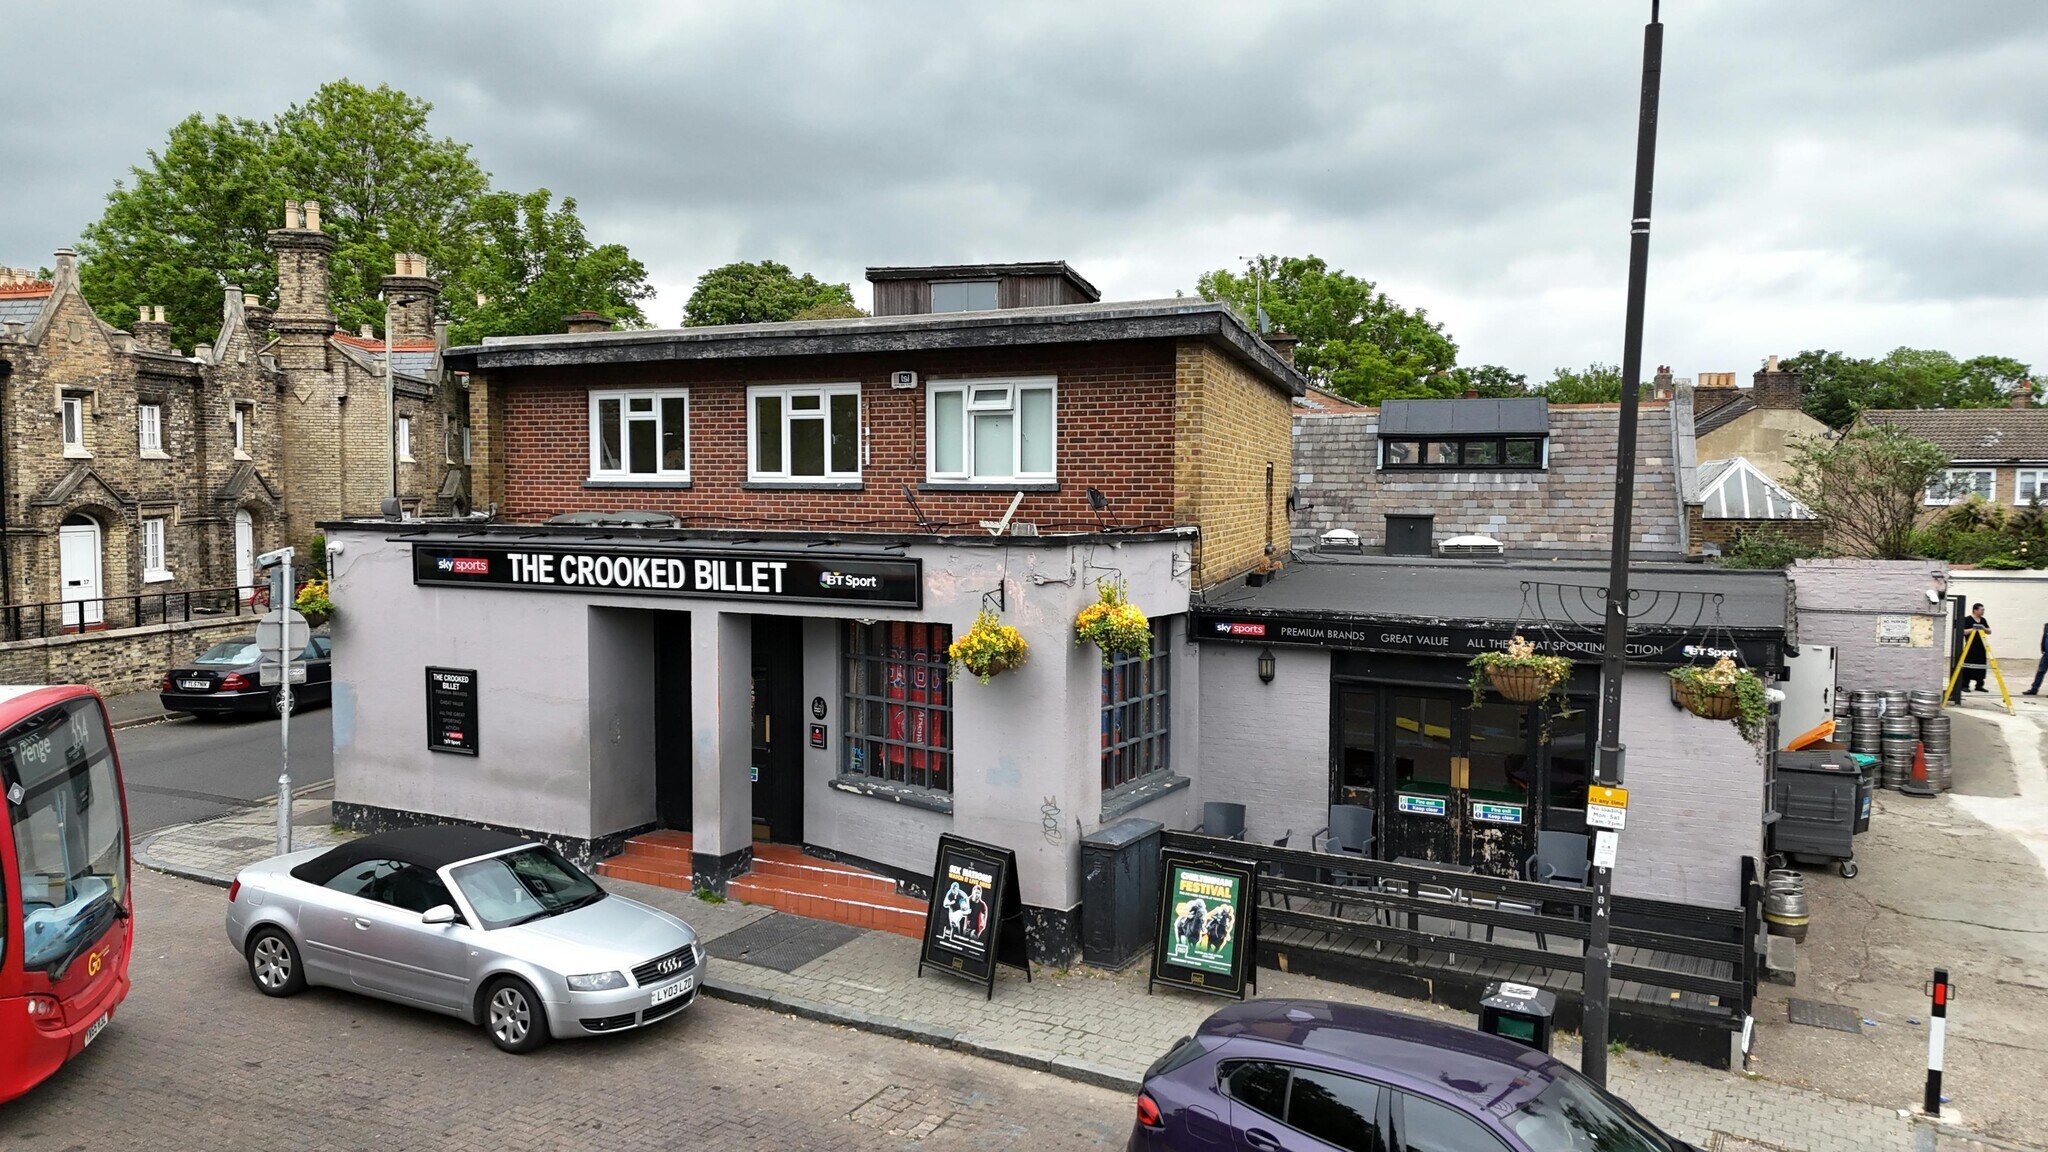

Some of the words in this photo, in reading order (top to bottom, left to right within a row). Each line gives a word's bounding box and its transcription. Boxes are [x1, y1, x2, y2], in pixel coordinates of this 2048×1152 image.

[438, 558, 454, 572] sky
[455, 560, 487, 572] sports
[507, 553, 555, 583] THE
[560, 554, 686, 589] CROOKED
[694, 559, 788, 593] BILLET
[826, 575, 844, 586] BT
[845, 575, 877, 588] Sport
[1216, 623, 1231, 634] sky
[1233, 624, 1263, 635] sports
[1281, 627, 1325, 638] PREMIUM
[1327, 630, 1365, 641] BRANDS
[1380, 633, 1413, 644] GREAT
[1415, 635, 1449, 646] VALUE
[1466, 638, 1486, 648] ALL
[1488, 639, 1508, 649] THE
[1552, 641, 1605, 652] SPORTIN
[1624, 643, 1663, 655] CTION
[1707, 647, 1738, 658] Sport
[433, 673, 443, 681] THE
[444, 675, 469, 683] CROOKED
[442, 682, 460, 690] BILLET
[20, 737, 51, 766] Penge
[1611, 799, 1625, 807] time
[949, 865, 961, 874] SIX
[962, 868, 993, 884] NATIONS
[1179, 880, 1232, 898] FESTIVAL
[657, 984, 678, 1001] LY03
